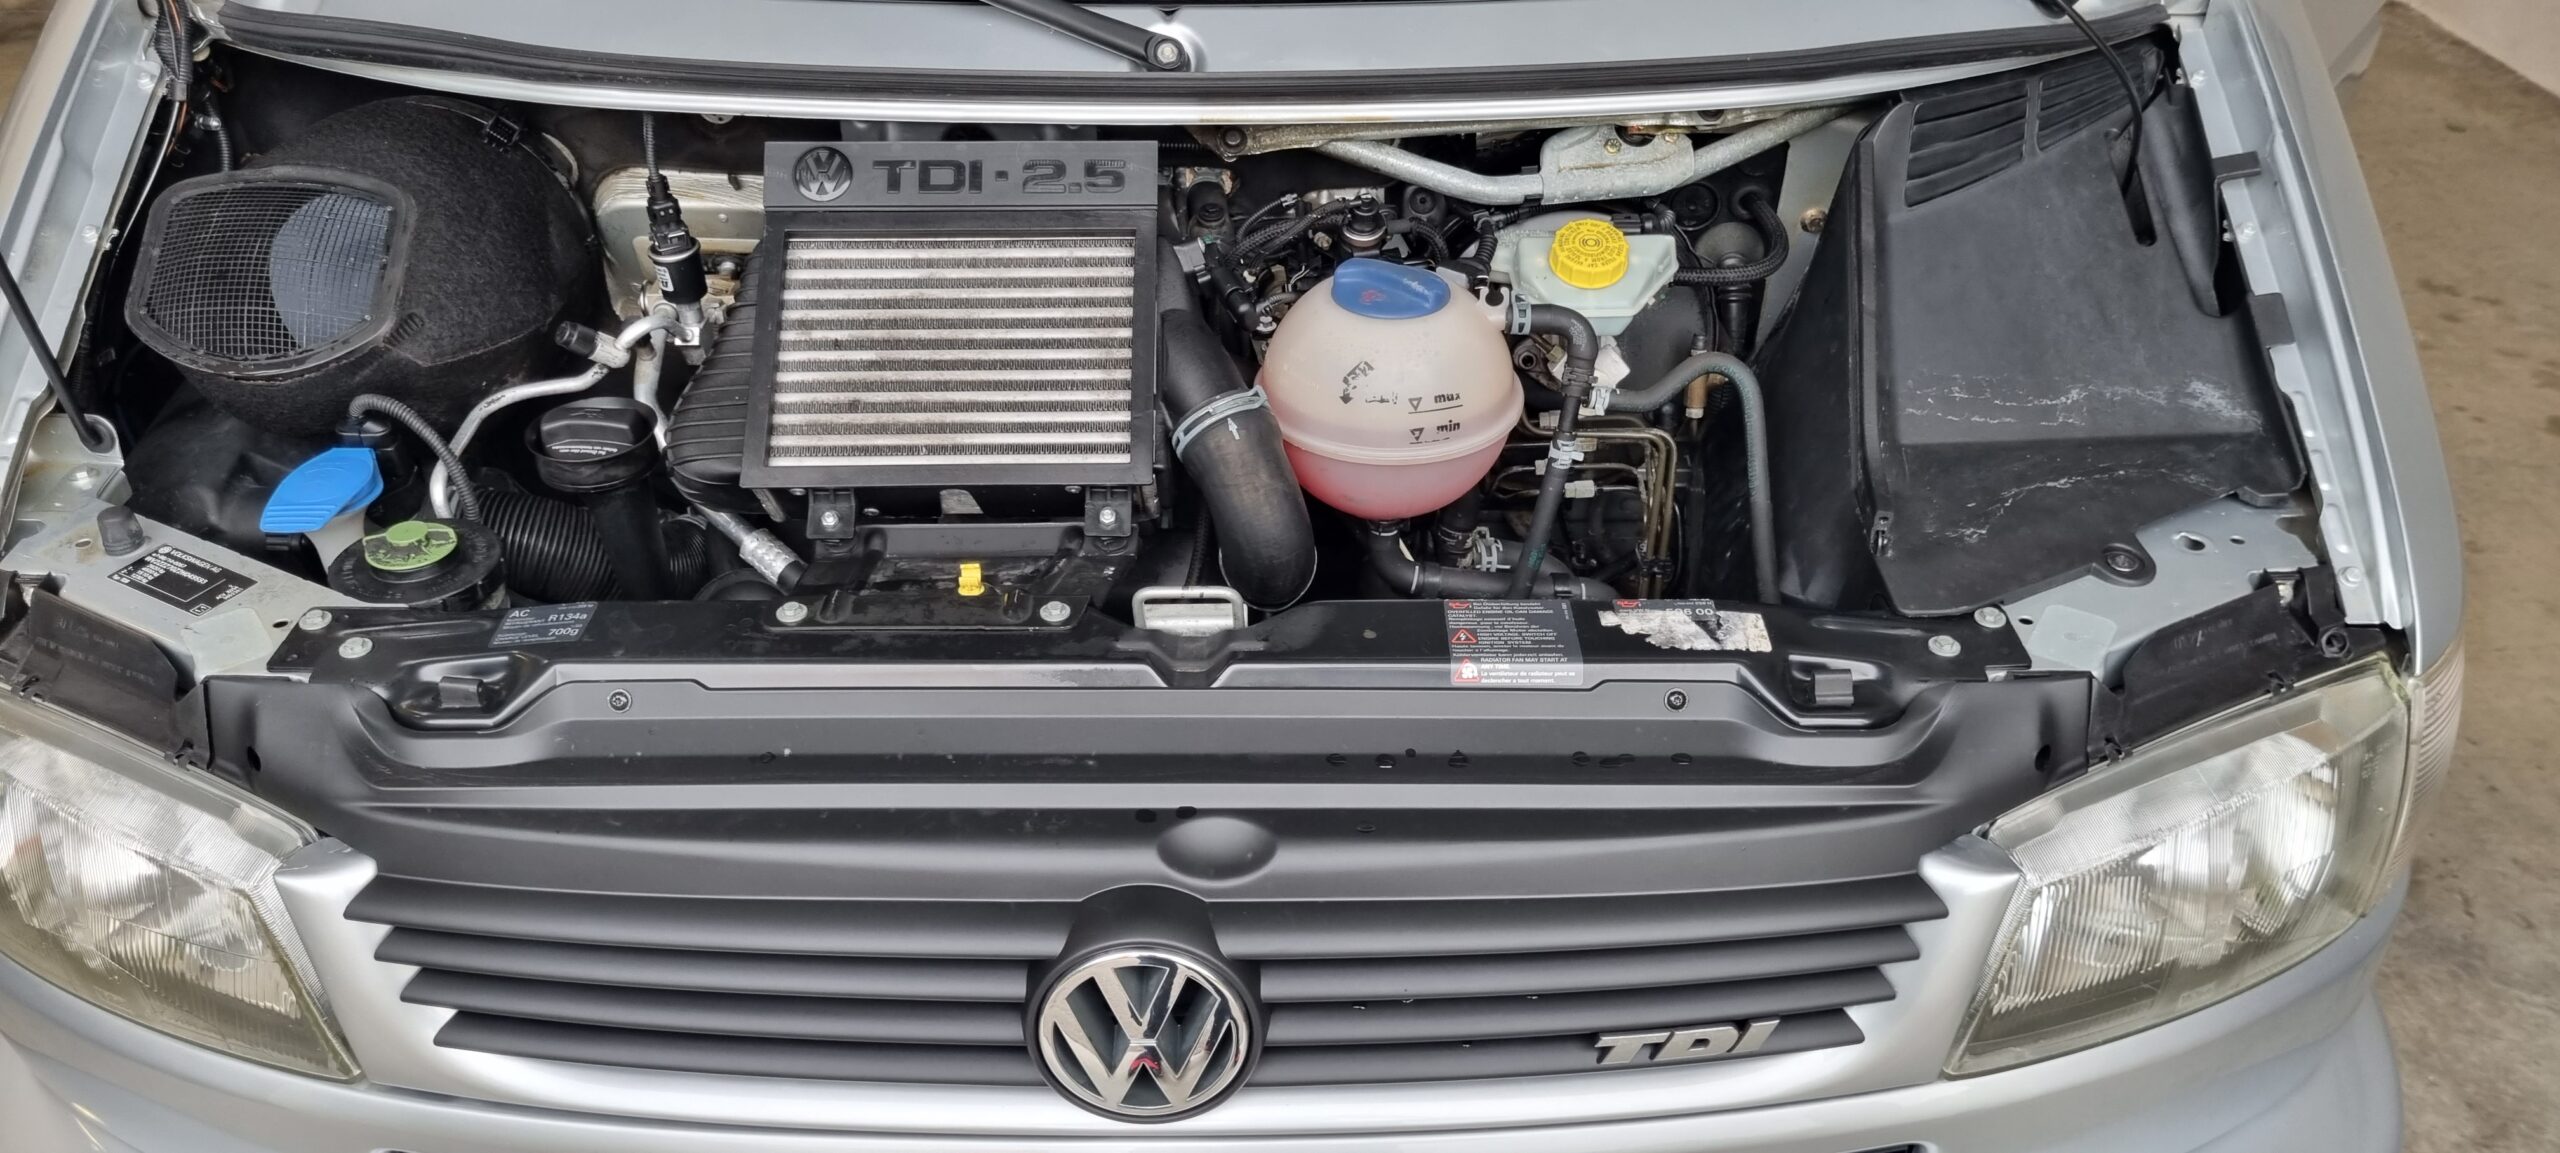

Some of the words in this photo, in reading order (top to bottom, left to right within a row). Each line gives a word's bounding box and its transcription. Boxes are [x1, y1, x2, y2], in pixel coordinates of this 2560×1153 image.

[873, 159, 983, 194] TDI
[1021, 159, 1127, 194] 2.5
[1436, 419, 1461, 433] min
[509, 609, 531, 618] AC
[547, 612, 587, 622] R134a
[548, 627, 580, 636] 700g
[1040, 950, 1248, 1116] VW
[1594, 1017, 1781, 1065] TDI
